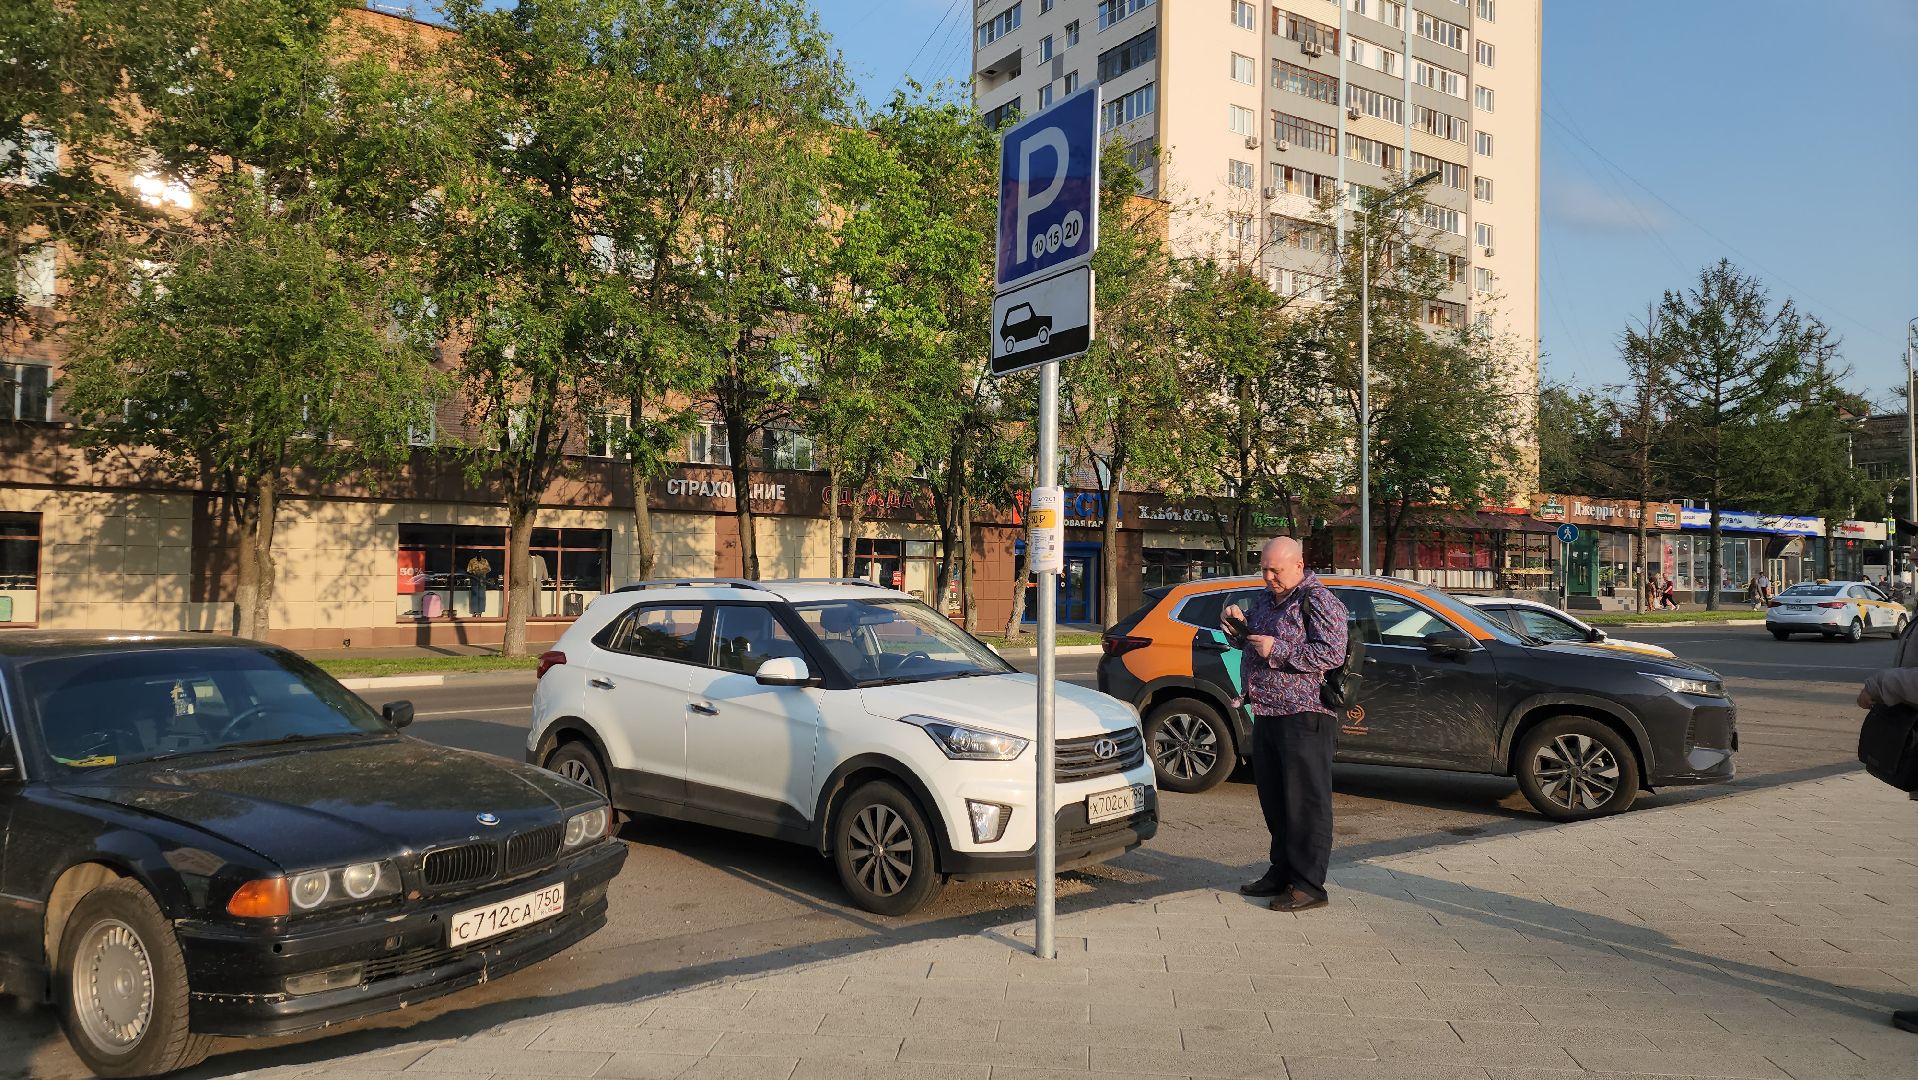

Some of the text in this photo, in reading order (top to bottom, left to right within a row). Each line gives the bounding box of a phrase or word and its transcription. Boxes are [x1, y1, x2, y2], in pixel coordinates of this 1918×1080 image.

[1016, 127, 1069, 264] P
[1034, 219, 1079, 254] 10 15 20
[667, 479, 786, 500] СТРАХОНИЕ
[536, 887, 560, 911] 750
